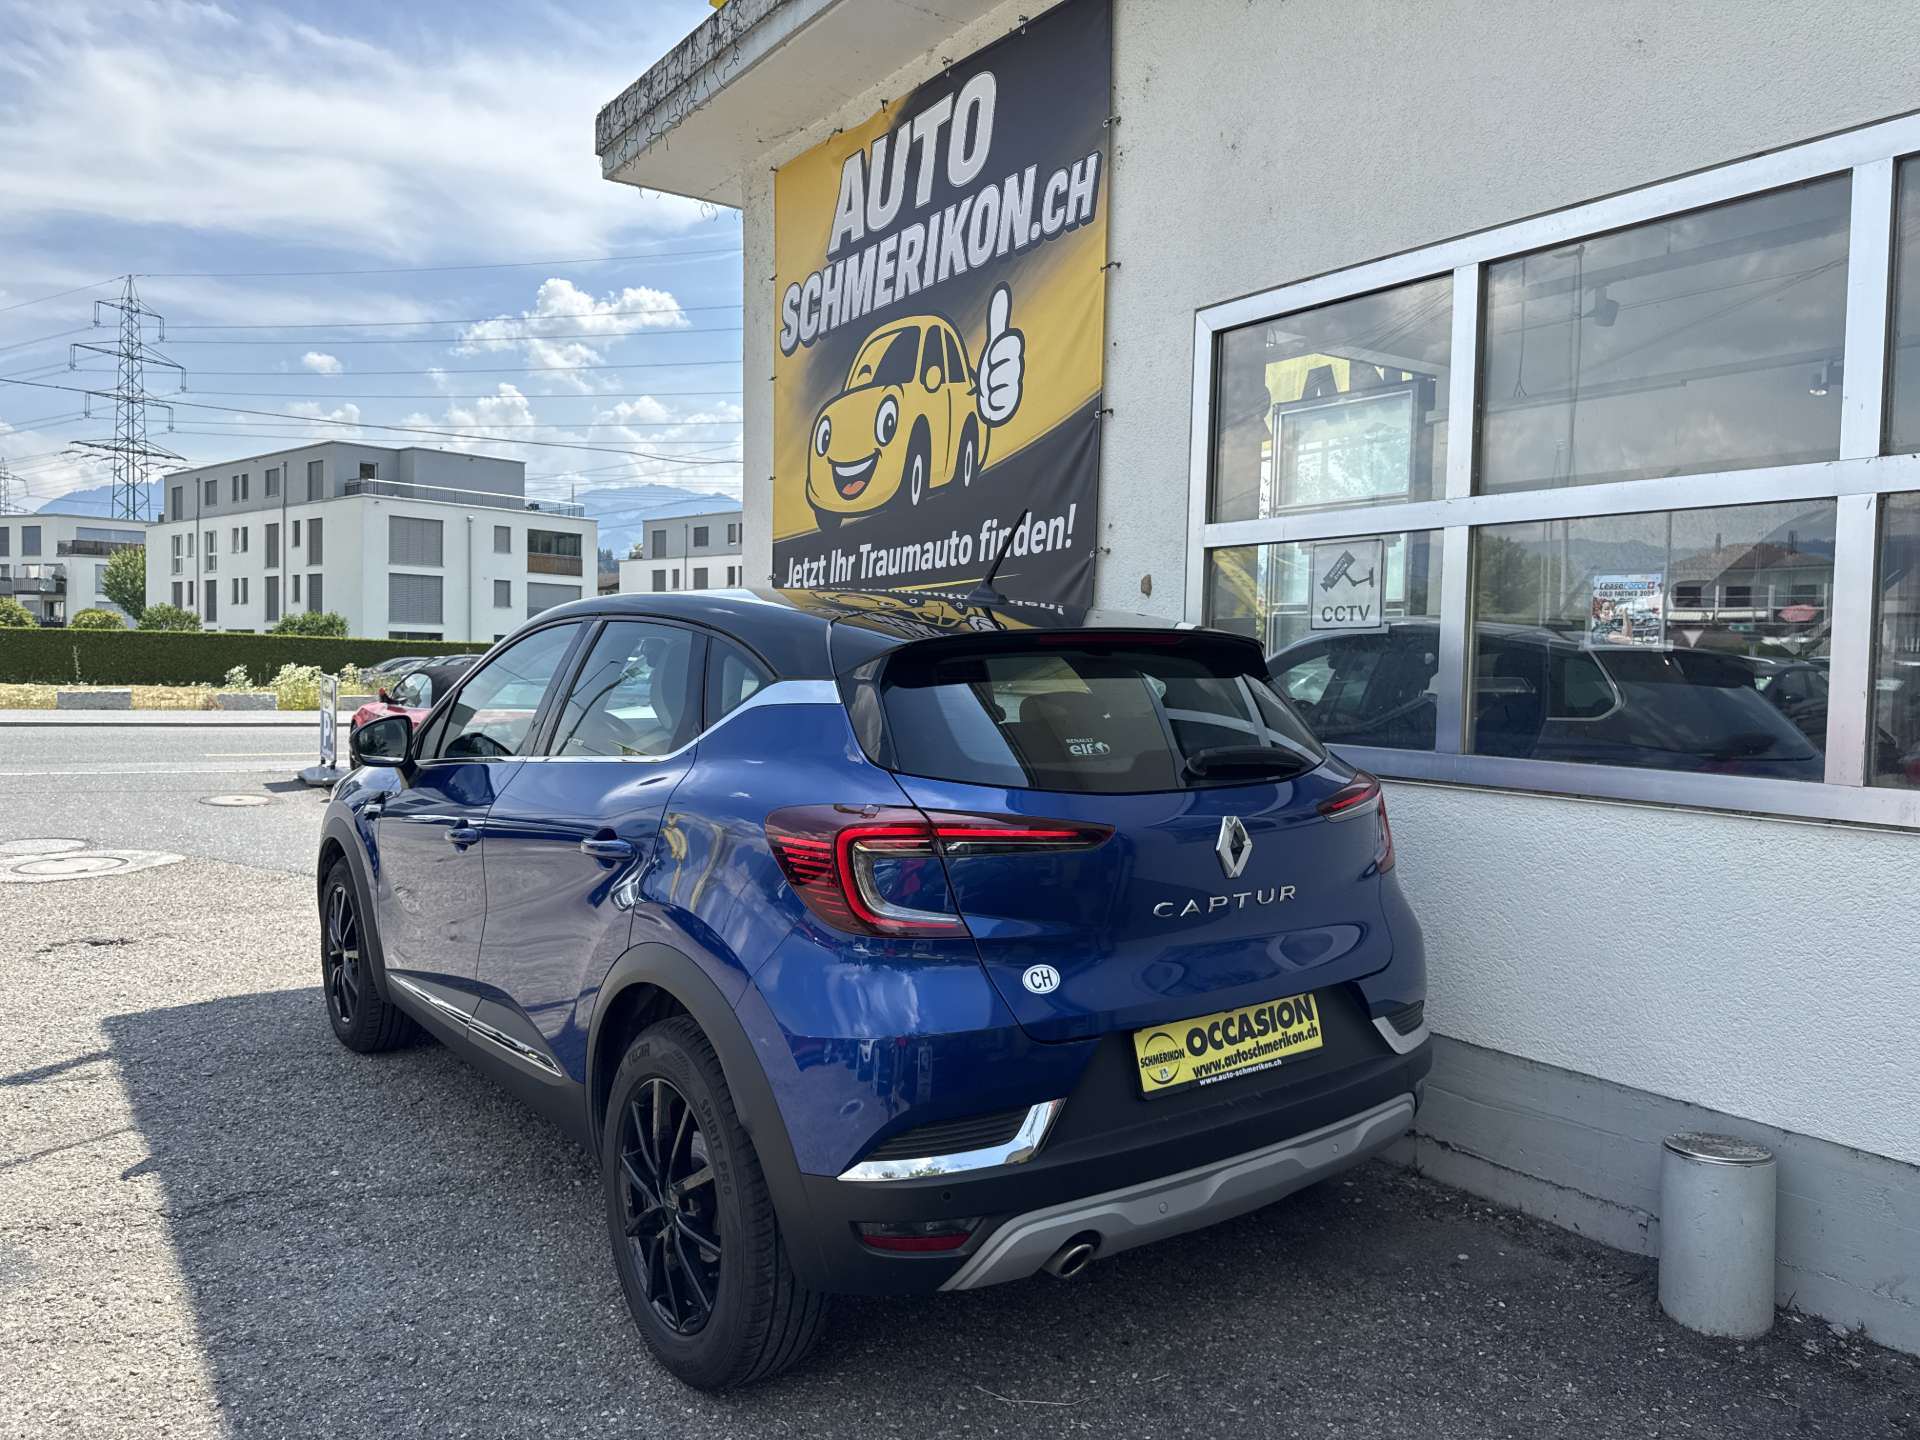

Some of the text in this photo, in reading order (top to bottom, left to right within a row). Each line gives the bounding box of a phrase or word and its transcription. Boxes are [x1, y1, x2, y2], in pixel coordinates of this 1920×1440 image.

[827, 70, 997, 254] AUTO
[780, 152, 1099, 352] SCHMERIKON.CH
[784, 504, 1077, 588] Jetzt Ihr Traumauto finden!
[1321, 604, 1371, 622] CCTV
[1069, 743, 1093, 755] elf
[1152, 884, 1297, 918] CAPTUR
[1030, 970, 1053, 990] CH
[1185, 995, 1315, 1057] OCCASION
[1140, 1048, 1186, 1069] SCHMERIKON
[1191, 1022, 1319, 1079] www.autoschmerikon.ch
[1199, 1058, 1283, 1087] www.auto-schmerikon.ch
